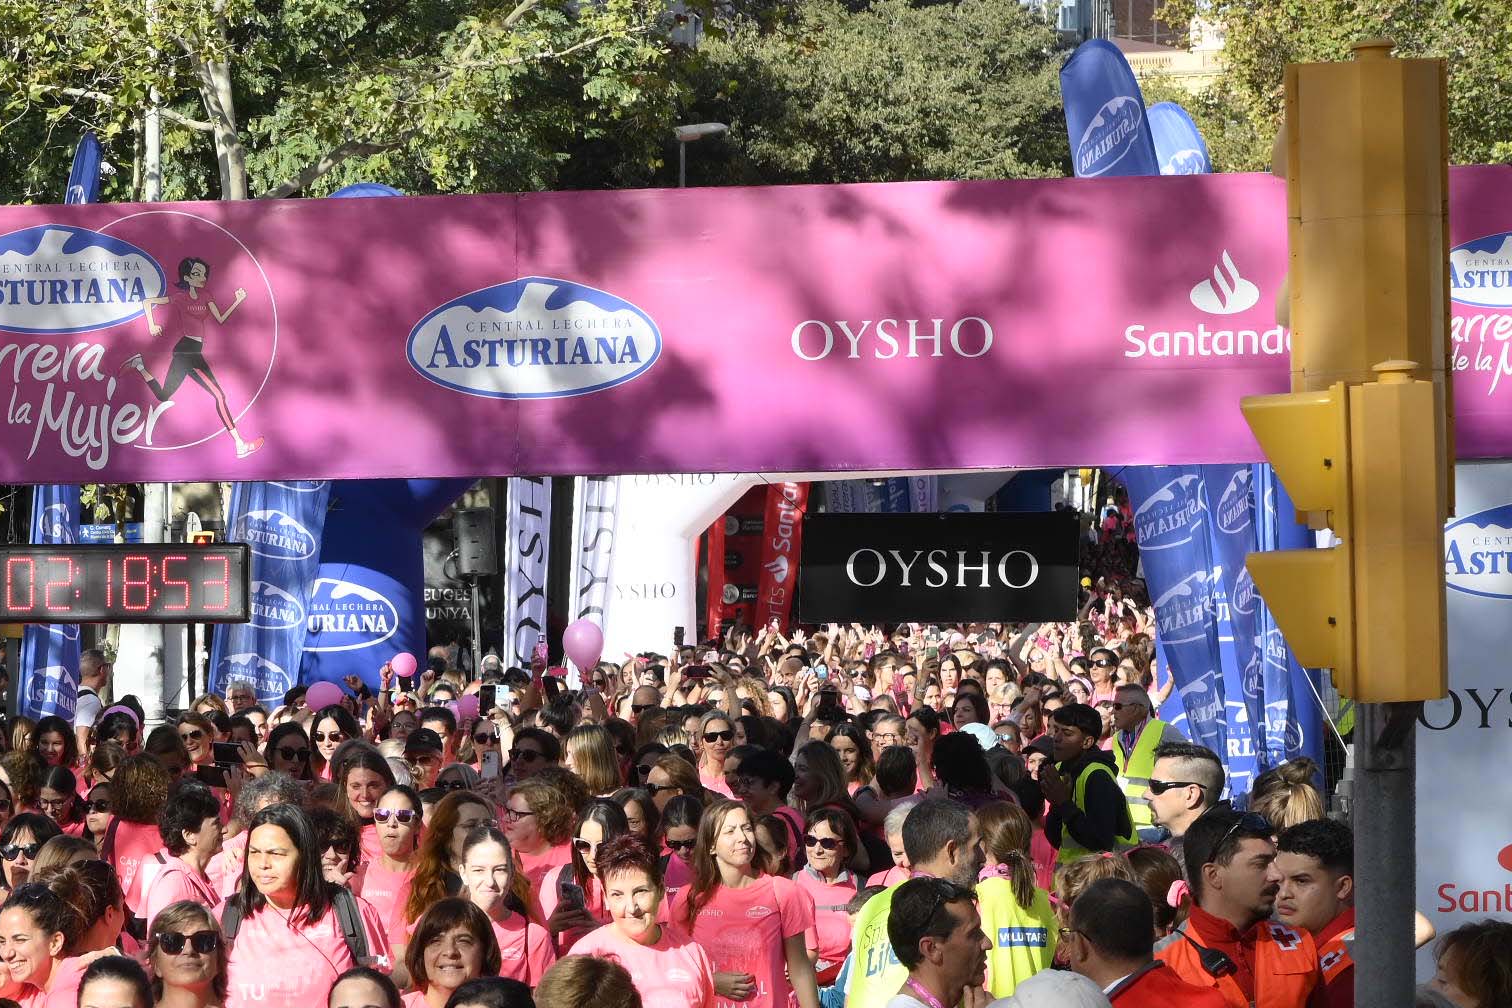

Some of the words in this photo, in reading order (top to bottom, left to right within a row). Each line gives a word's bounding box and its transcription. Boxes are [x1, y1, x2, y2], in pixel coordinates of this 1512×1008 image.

[69, 261, 141, 273] LECHERA
[466, 321, 544, 333] CENTRAL
[553, 318, 633, 330] LECHERA
[426, 324, 642, 369] ASTURIANA
[791, 316, 994, 361] OYSHO
[1124, 324, 1291, 359] Santand
[1475, 342, 1493, 371] la
[7, 387, 32, 425] la
[26, 377, 176, 471] Mujer
[235, 524, 307, 556] ASTURIANA
[845, 548, 1040, 588] OYSHO
[6, 555, 230, 612] 02:18:53
[615, 581, 677, 600] YSHO
[424, 588, 471, 603] EUGES
[251, 602, 296, 624] URIANA
[335, 603, 384, 612] LECHERA
[426, 606, 471, 620] UNYA
[308, 613, 388, 633] URIANA
[239, 983, 265, 1001] TU
